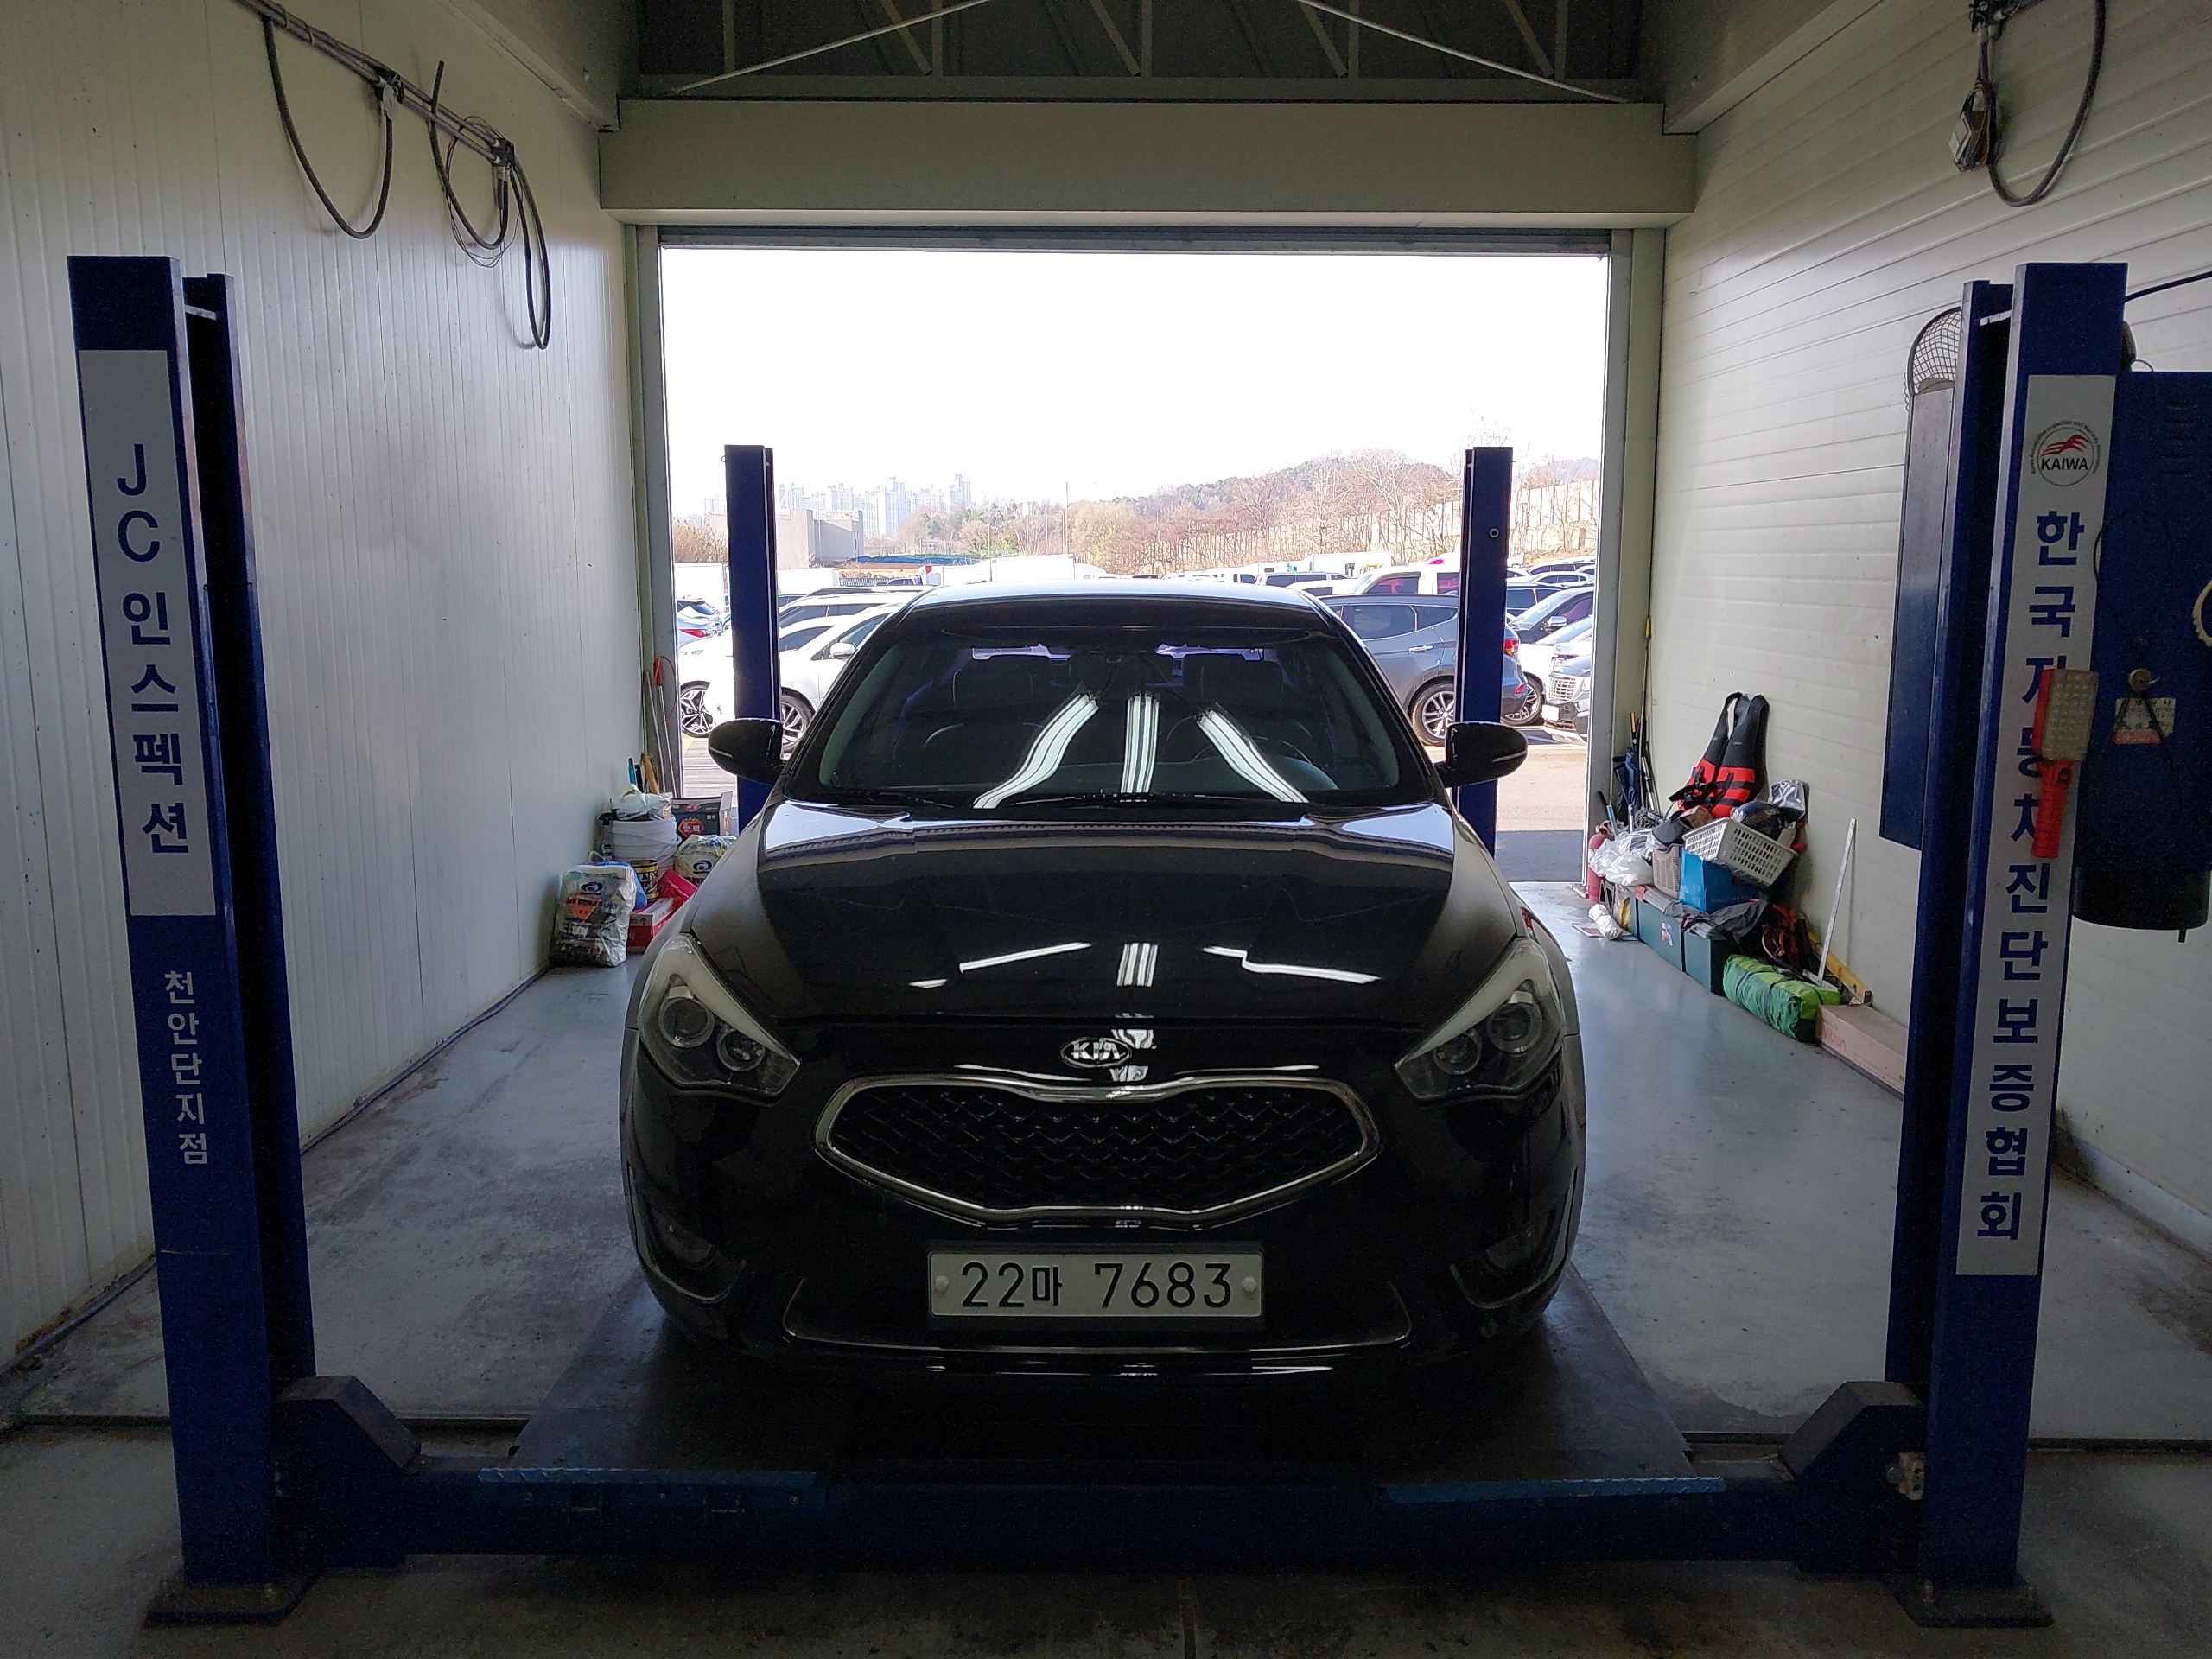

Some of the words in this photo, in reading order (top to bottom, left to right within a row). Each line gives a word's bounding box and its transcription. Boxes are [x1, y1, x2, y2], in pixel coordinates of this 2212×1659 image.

[2041, 458, 2088, 471] KAIWA
[117, 443, 189, 855] JC인스펙션
[164, 970, 208, 1166] 천안단지점
[1071, 1041, 1121, 1061] KIA
[961, 1262, 1063, 1309] 22마
[1094, 1262, 1232, 1309] 7683
